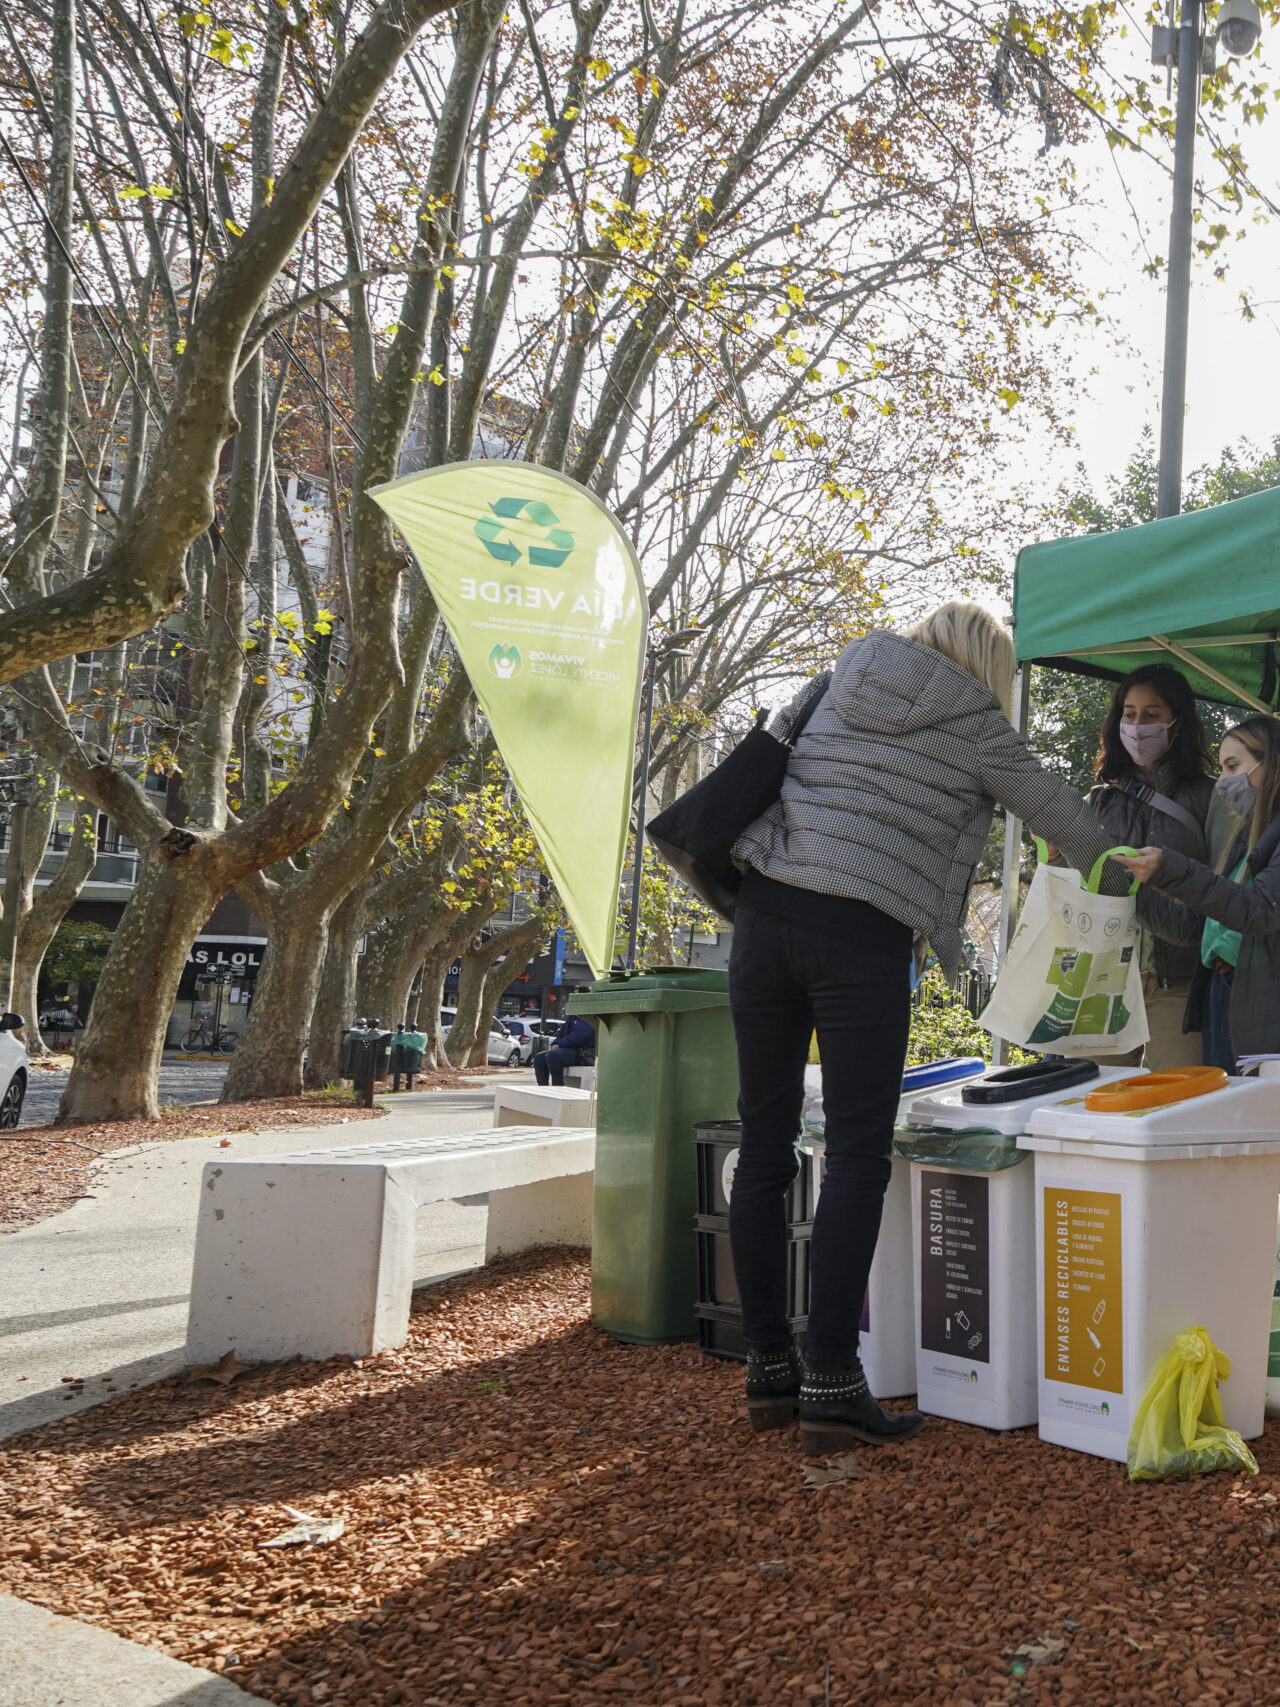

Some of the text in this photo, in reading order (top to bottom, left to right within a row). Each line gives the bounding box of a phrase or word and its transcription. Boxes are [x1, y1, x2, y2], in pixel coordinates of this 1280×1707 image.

[930, 1187, 943, 1256] BASURA
[1056, 1200, 1070, 1372] ENVASES RECICLABLES
